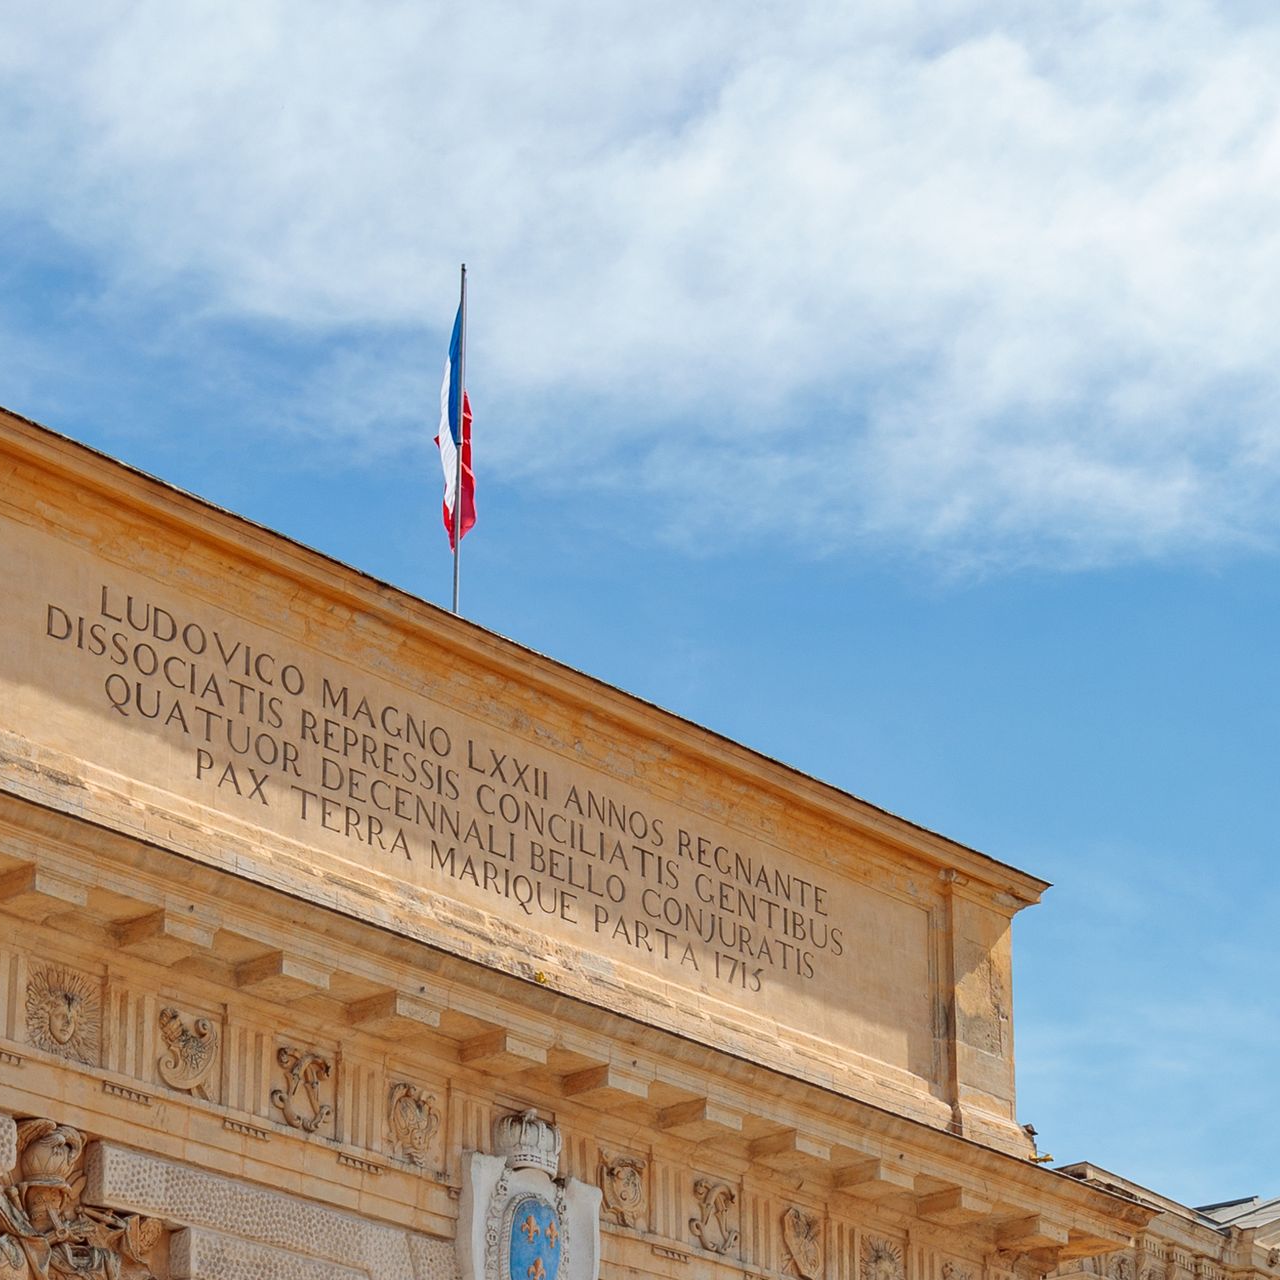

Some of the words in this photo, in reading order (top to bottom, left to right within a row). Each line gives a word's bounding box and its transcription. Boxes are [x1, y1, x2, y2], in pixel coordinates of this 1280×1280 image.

[46, 604, 284, 729] DISSOCIATIS
[300, 708, 461, 801] REPRESSIS
[476, 783, 680, 890] CONCILIATIS
[695, 872, 844, 957] GENTIBUS
[101, 585, 305, 696] LUDOVICO
[322, 678, 452, 758] MAGNO
[467, 739, 549, 801] LXXII
[564, 784, 665, 847] ANNOS
[678, 828, 829, 917] REGNANTE
[104, 673, 303, 777] QUATUOR
[322, 756, 516, 861] DECENNALI
[530, 840, 626, 903] BELLO
[641, 888, 815, 980] CONJURATIS
[196, 748, 269, 806] PAX
[291, 784, 413, 861] TERRA
[429, 839, 578, 925] MARIQUE
[594, 904, 700, 971] PARTA
[714, 951, 764, 993] 1715
